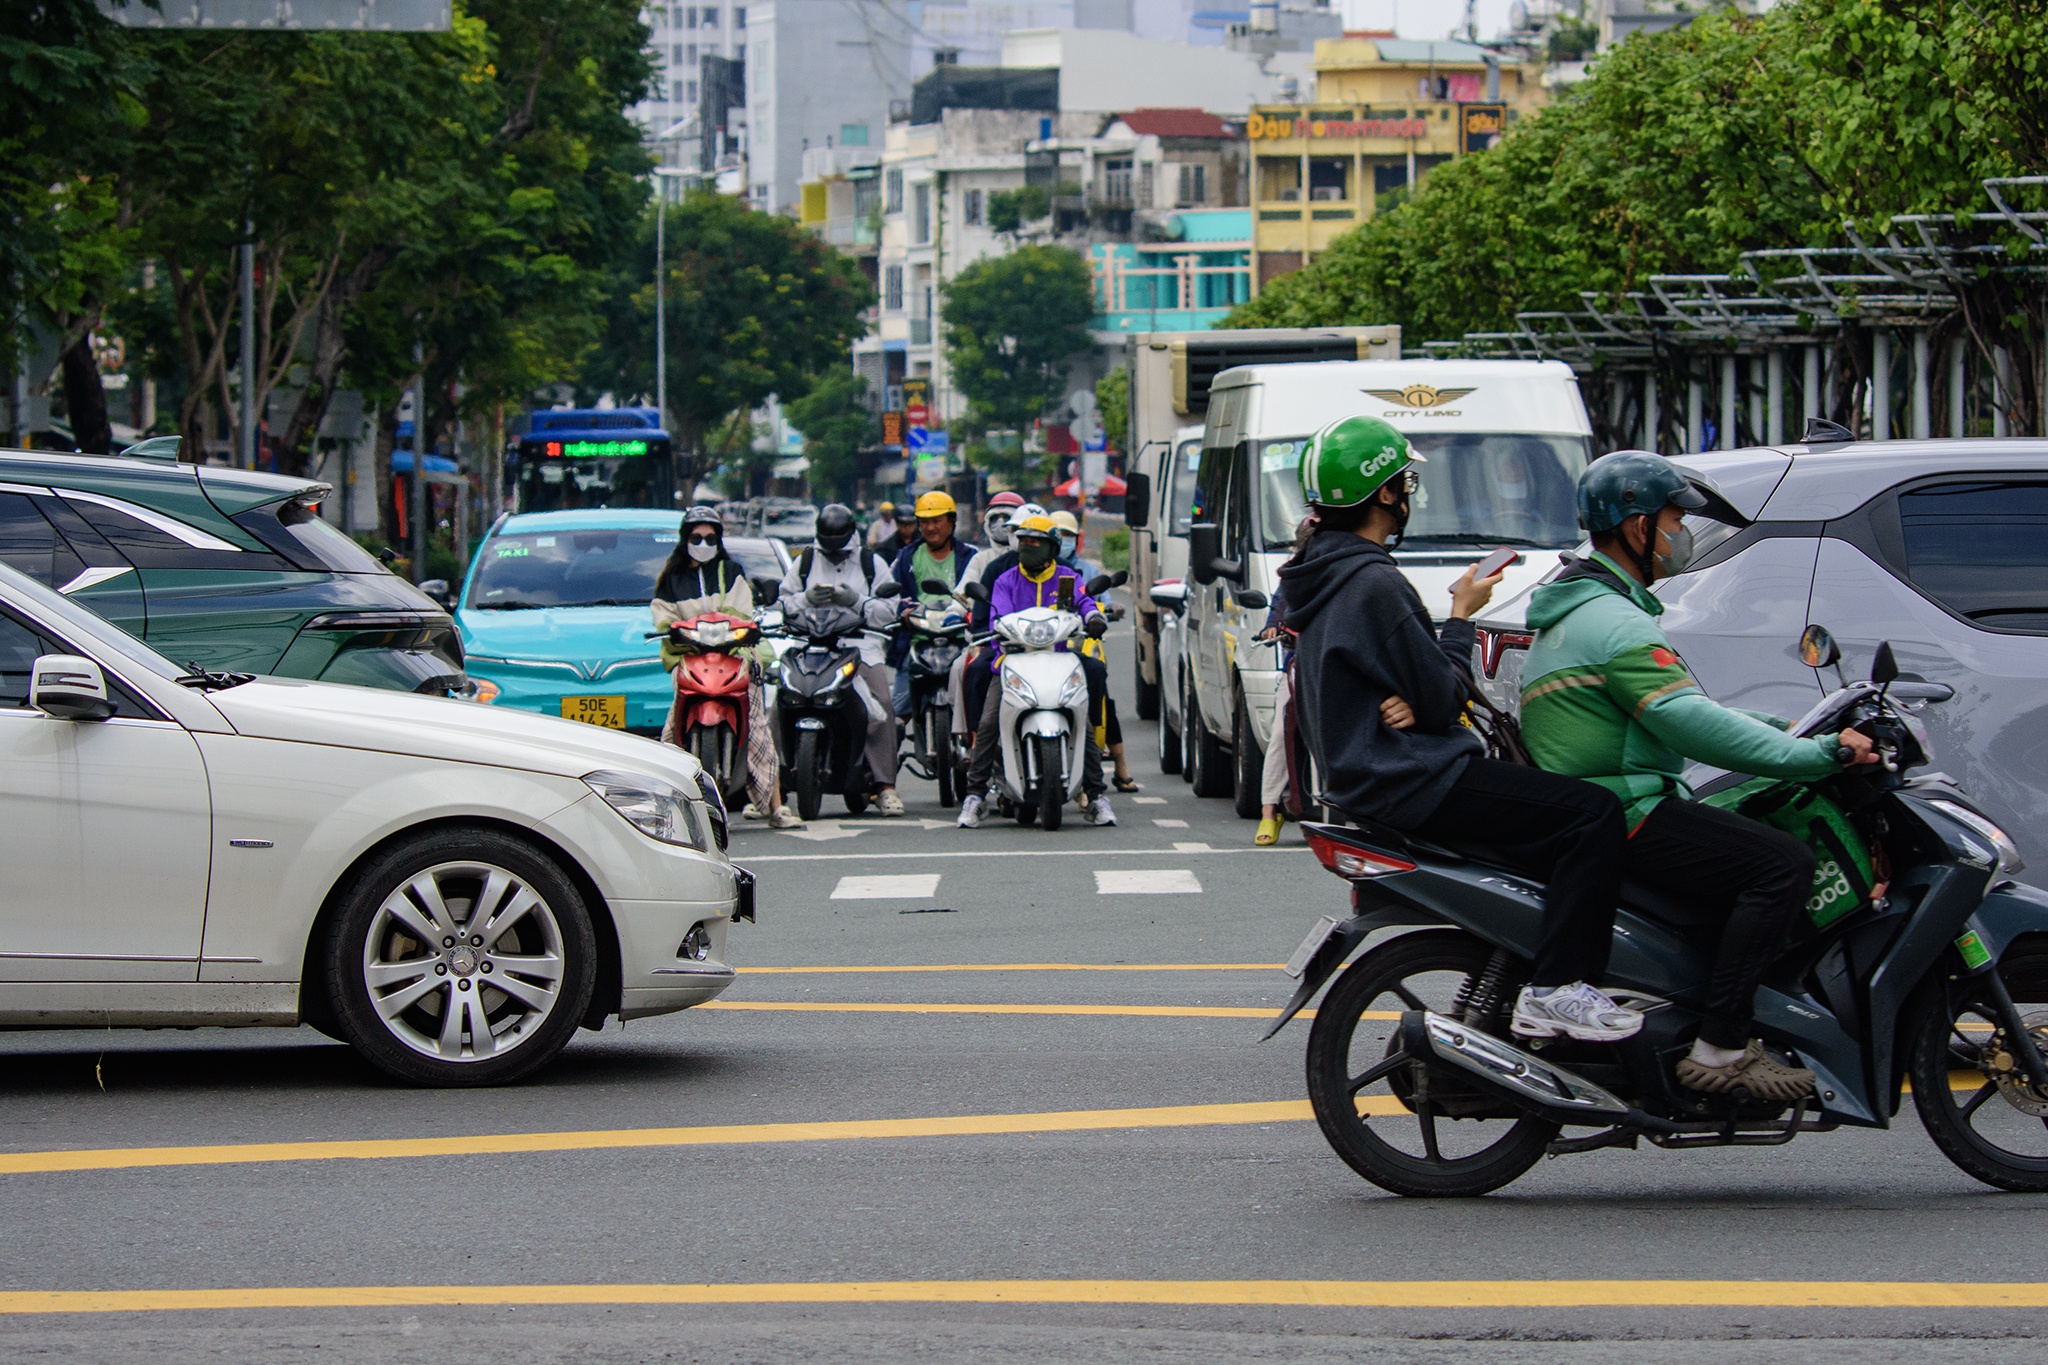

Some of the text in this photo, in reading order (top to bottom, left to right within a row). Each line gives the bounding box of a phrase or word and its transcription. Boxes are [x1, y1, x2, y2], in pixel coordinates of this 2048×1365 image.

[1296, 116, 1427, 138] homemade
[1383, 410, 1420, 418] CITY
[1360, 446, 1398, 477] Grab
[497, 547, 529, 558] TAXI
[579, 698, 607, 712] 50E
[1812, 860, 1840, 885] ab
[1805, 871, 1851, 911] ood
